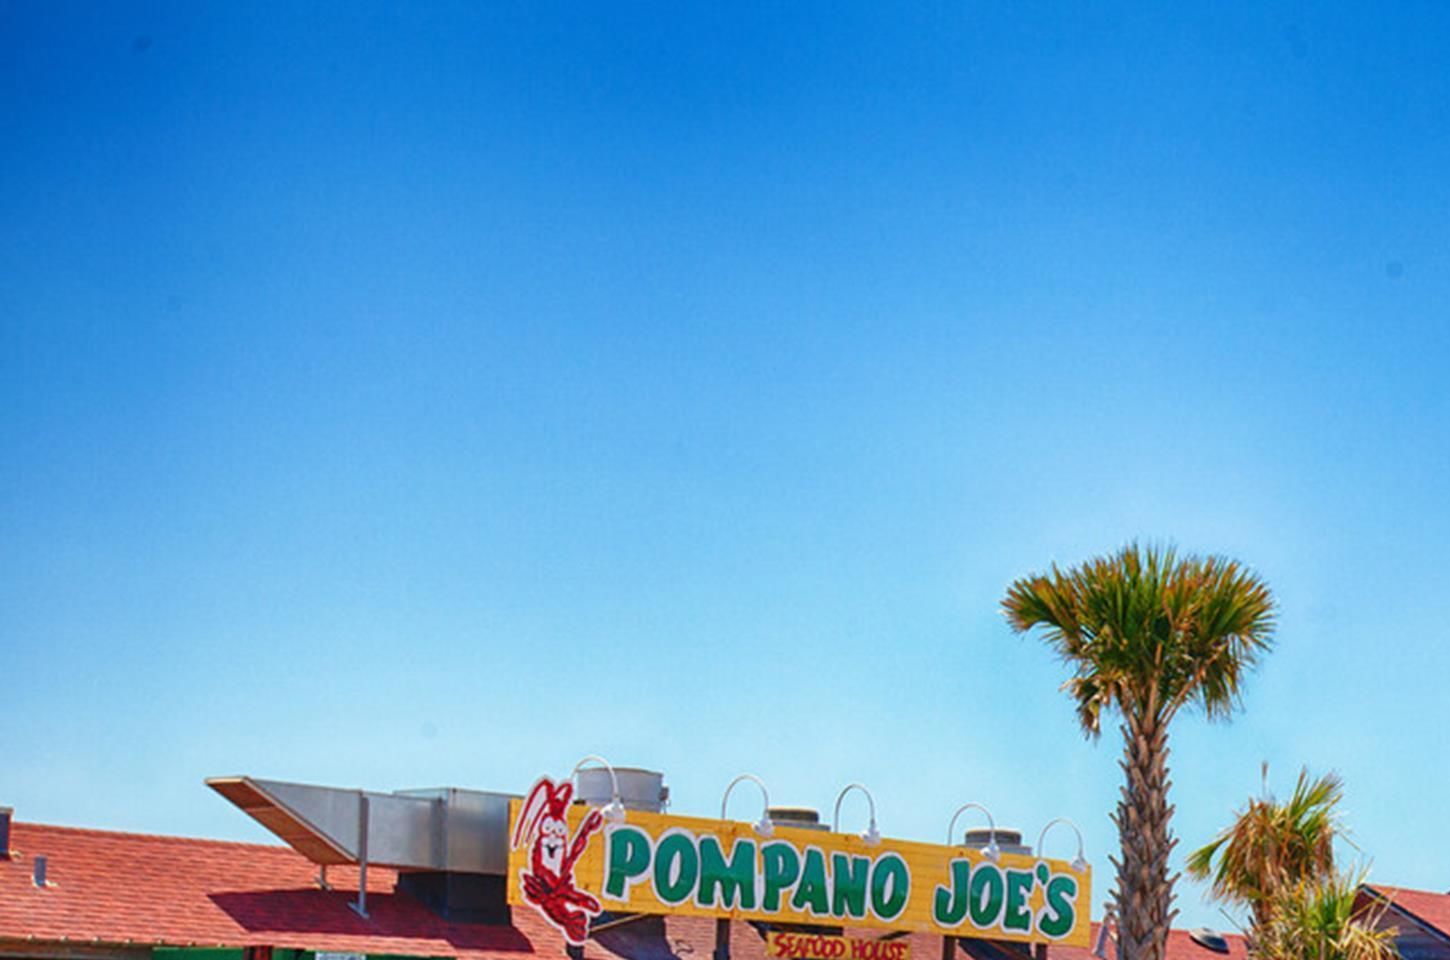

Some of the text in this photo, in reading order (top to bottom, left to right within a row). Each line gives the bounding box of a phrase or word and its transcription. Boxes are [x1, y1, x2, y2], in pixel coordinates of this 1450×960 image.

[604, 827, 1078, 938] POMPANO JOE'S
[774, 933, 846, 958] SEAFOOD
